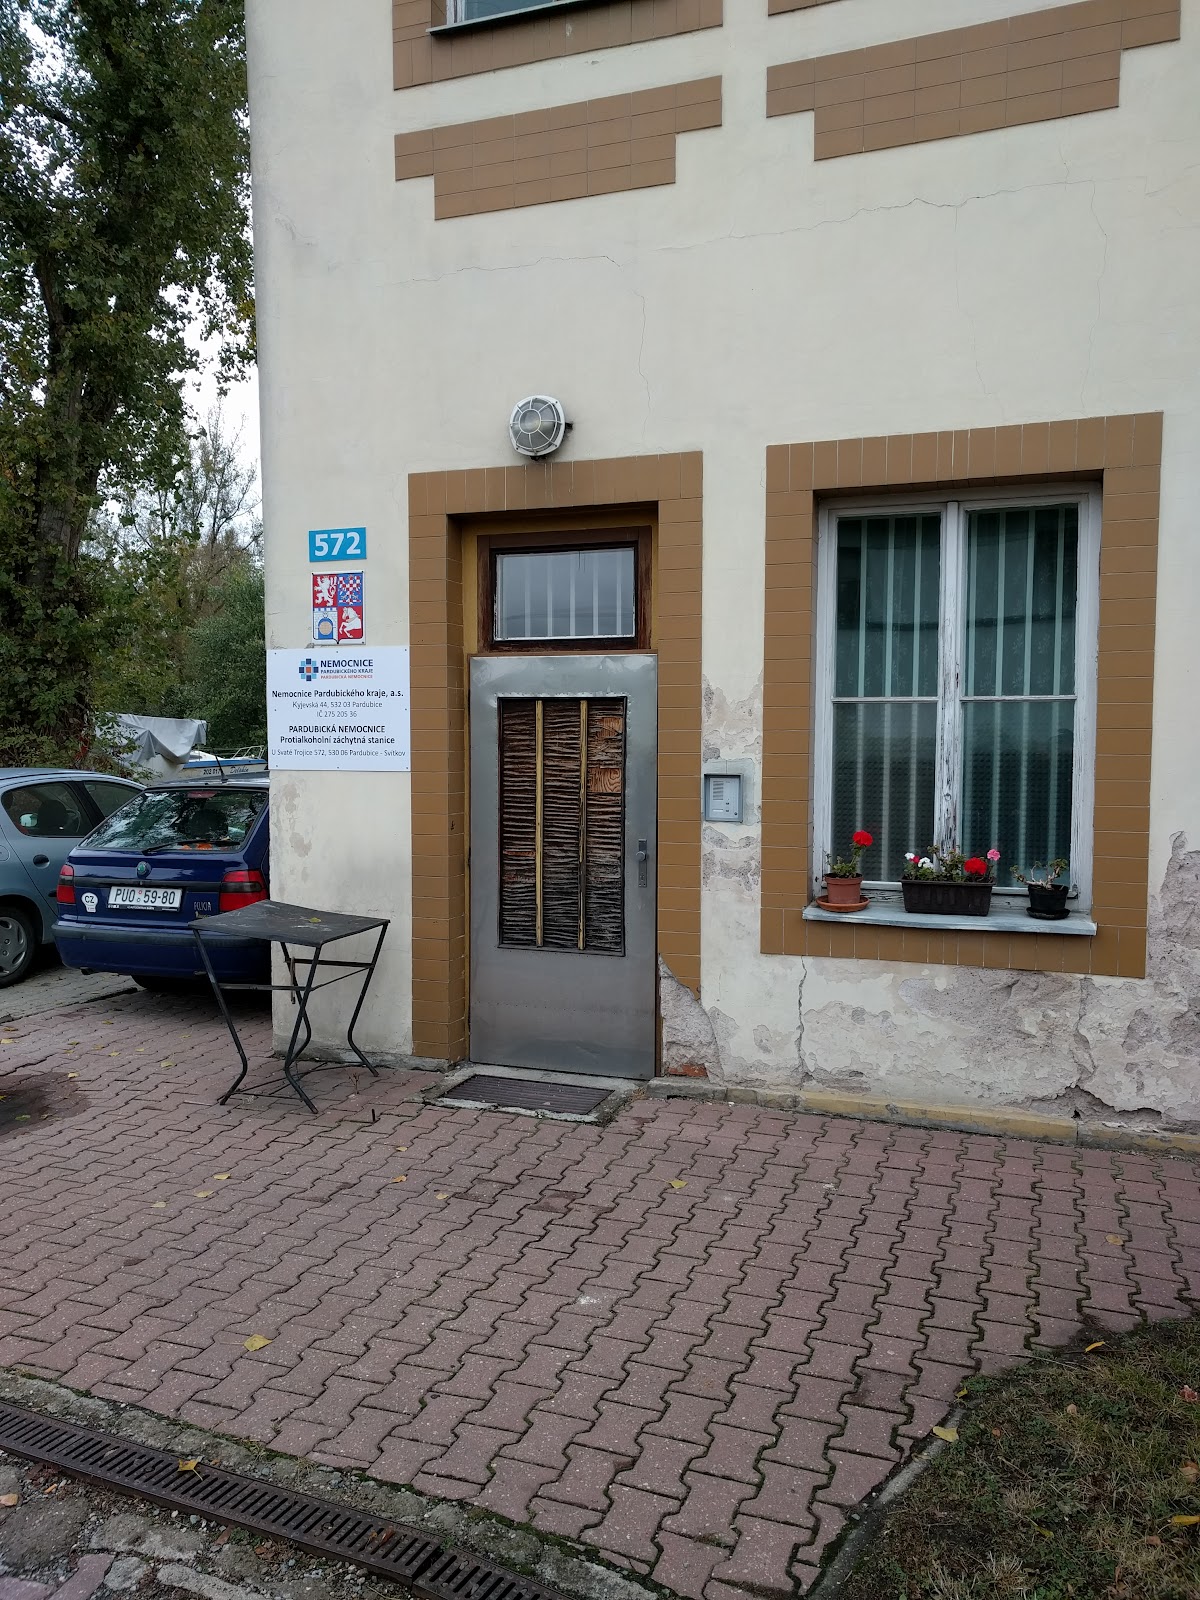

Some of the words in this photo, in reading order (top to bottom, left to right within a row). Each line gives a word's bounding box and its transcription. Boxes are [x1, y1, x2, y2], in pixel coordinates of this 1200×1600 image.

[315, 531, 361, 557] 572
[320, 659, 374, 668] NEMOCNICE
[271, 690, 312, 698] Nemocnice
[314, 689, 365, 697] Pardubického
[366, 689, 388, 699] kraje,
[292, 701, 319, 710] Kyjevská
[324, 710, 336, 718] 275
[336, 710, 348, 718] 205
[349, 710, 358, 718] 36
[289, 723, 337, 733] PARDUBICKÁ
[338, 725, 386, 733] NEMOCNICE
[280, 735, 332, 744] Protialkoholní
[332, 735, 366, 745] záchytná
[367, 735, 396, 744] stanice
[293, 749, 313, 757] Trojice
[314, 749, 327, 757] 572,
[349, 749, 379, 757] Pardubice
[384, 749, 406, 757] Svítkov
[84, 895, 95, 904] CZ
[143, 889, 176, 905] 59-80
